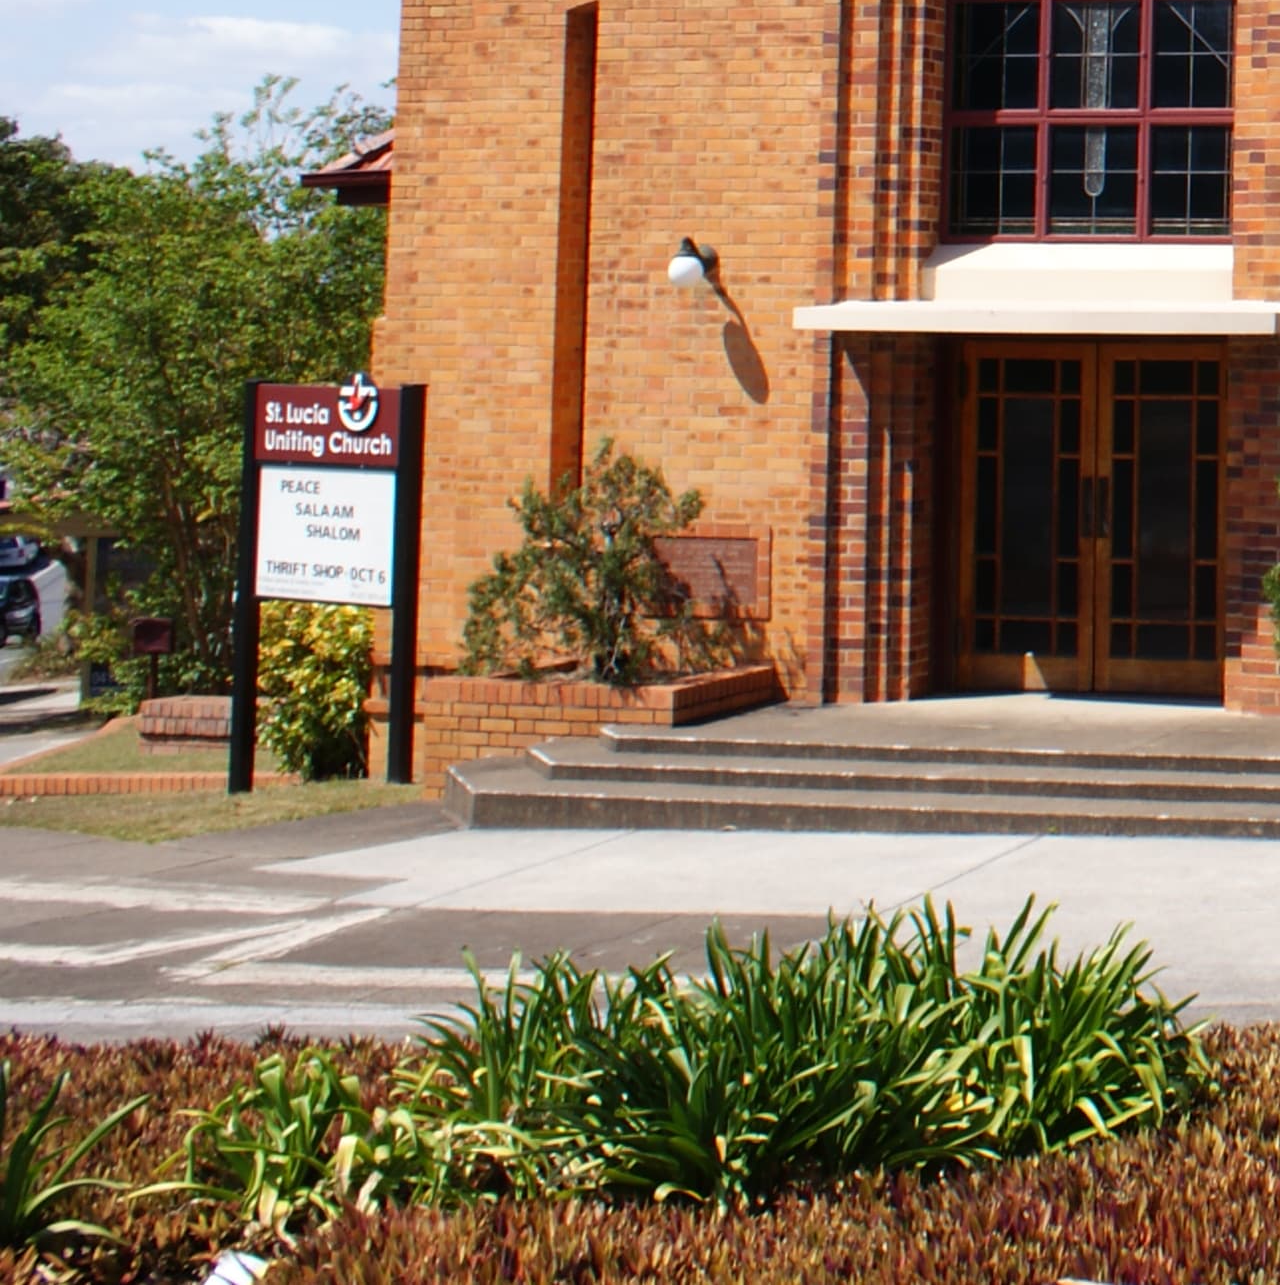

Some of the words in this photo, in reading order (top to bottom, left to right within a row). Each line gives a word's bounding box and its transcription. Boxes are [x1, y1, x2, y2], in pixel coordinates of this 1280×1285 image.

[265, 401, 284, 423] St.
[286, 402, 330, 425] Lucia
[264, 429, 325, 458] Uniting
[328, 431, 393, 455] Church
[280, 479, 321, 495] PEACE
[295, 502, 355, 518] SALAAM
[306, 524, 361, 541] SHALOM
[266, 560, 307, 575] THRIFT
[313, 564, 345, 579] SHOP
[377, 570, 386, 584] 6
